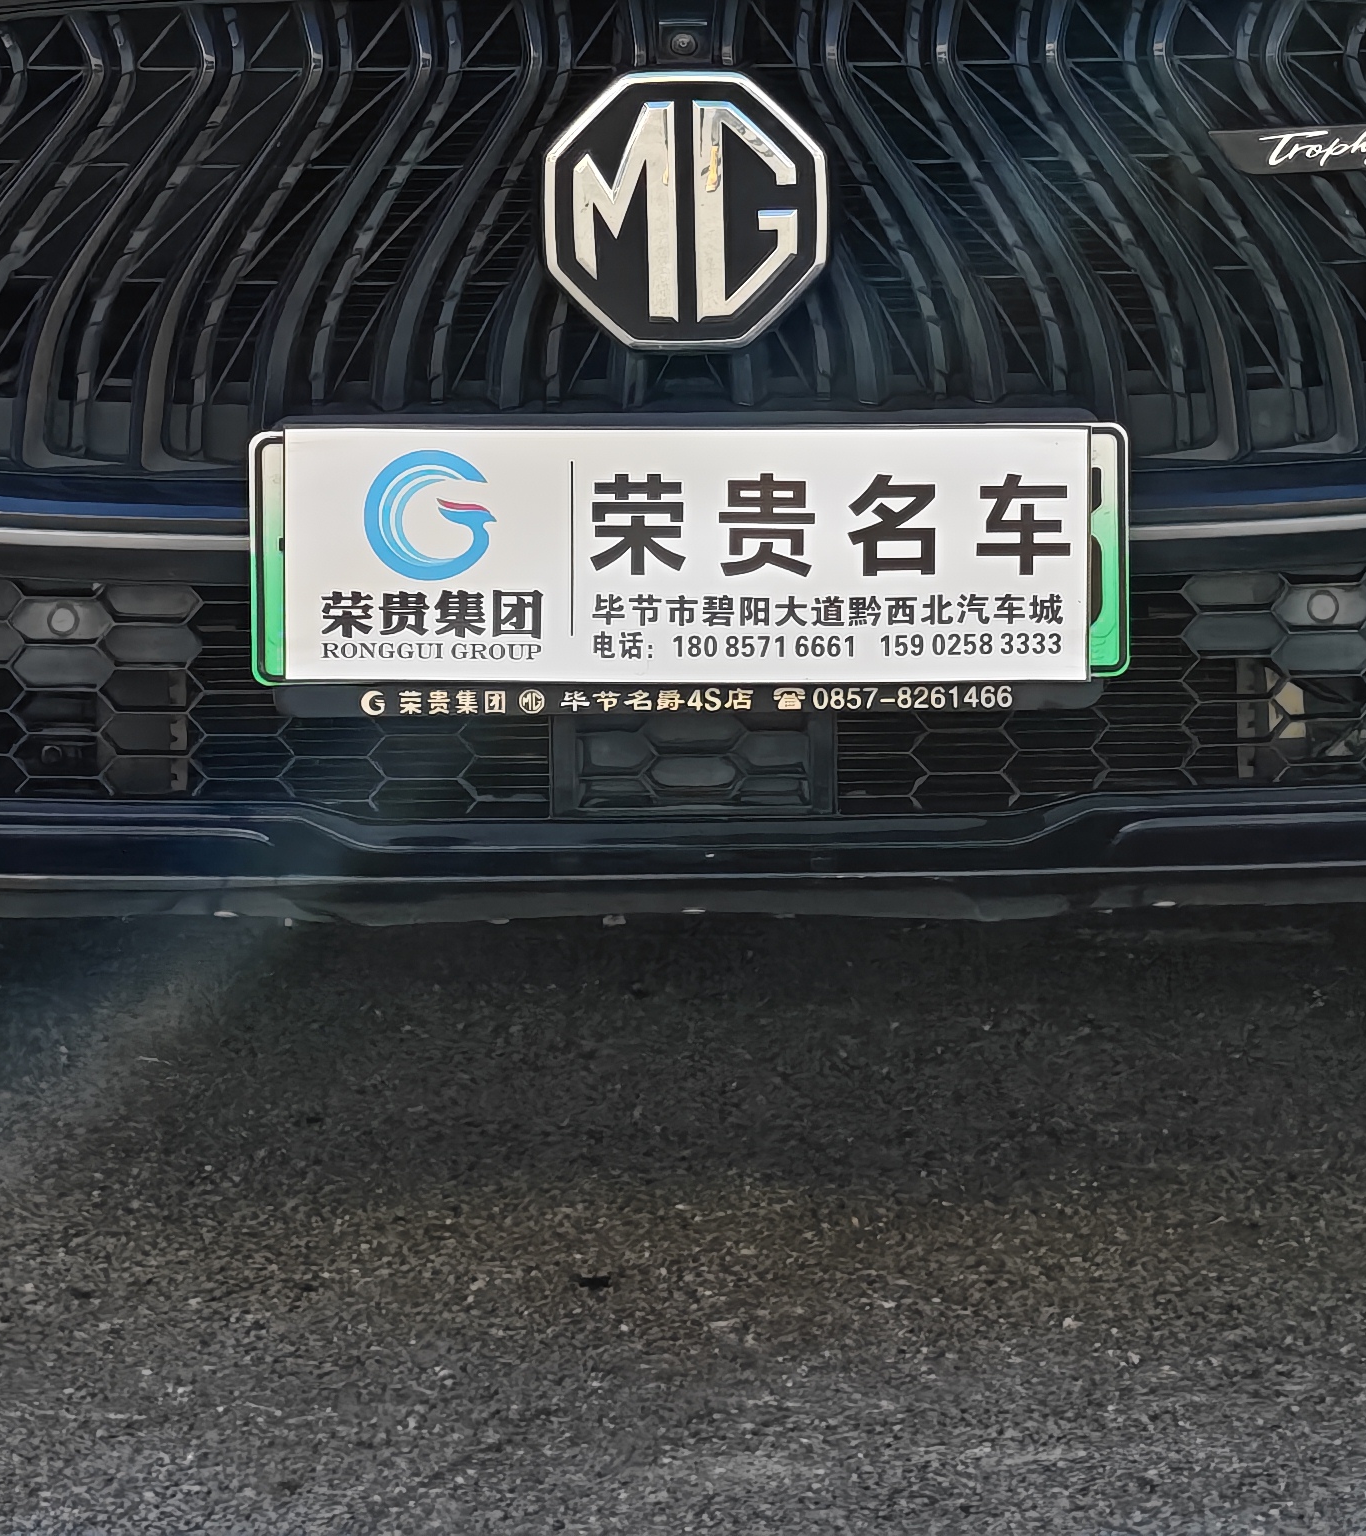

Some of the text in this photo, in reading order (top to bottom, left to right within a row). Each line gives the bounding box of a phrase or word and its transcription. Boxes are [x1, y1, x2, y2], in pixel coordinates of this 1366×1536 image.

[573, 100, 798, 323] MG
[590, 473, 1072, 577] 荣贵名车
[321, 589, 544, 639] 荣贵集团
[592, 593, 1064, 627] 毕节市碧阳大道黔西北汽车城
[321, 642, 542, 660] RONGGUI GROUP
[593, 630, 1063, 659] 电话： 180 8571 6661 159 0258 3333
[398, 690, 506, 714] 荣贵集团
[560, 687, 754, 712] 毕节名爵4S店
[812, 685, 1013, 710] 0857-8261466
